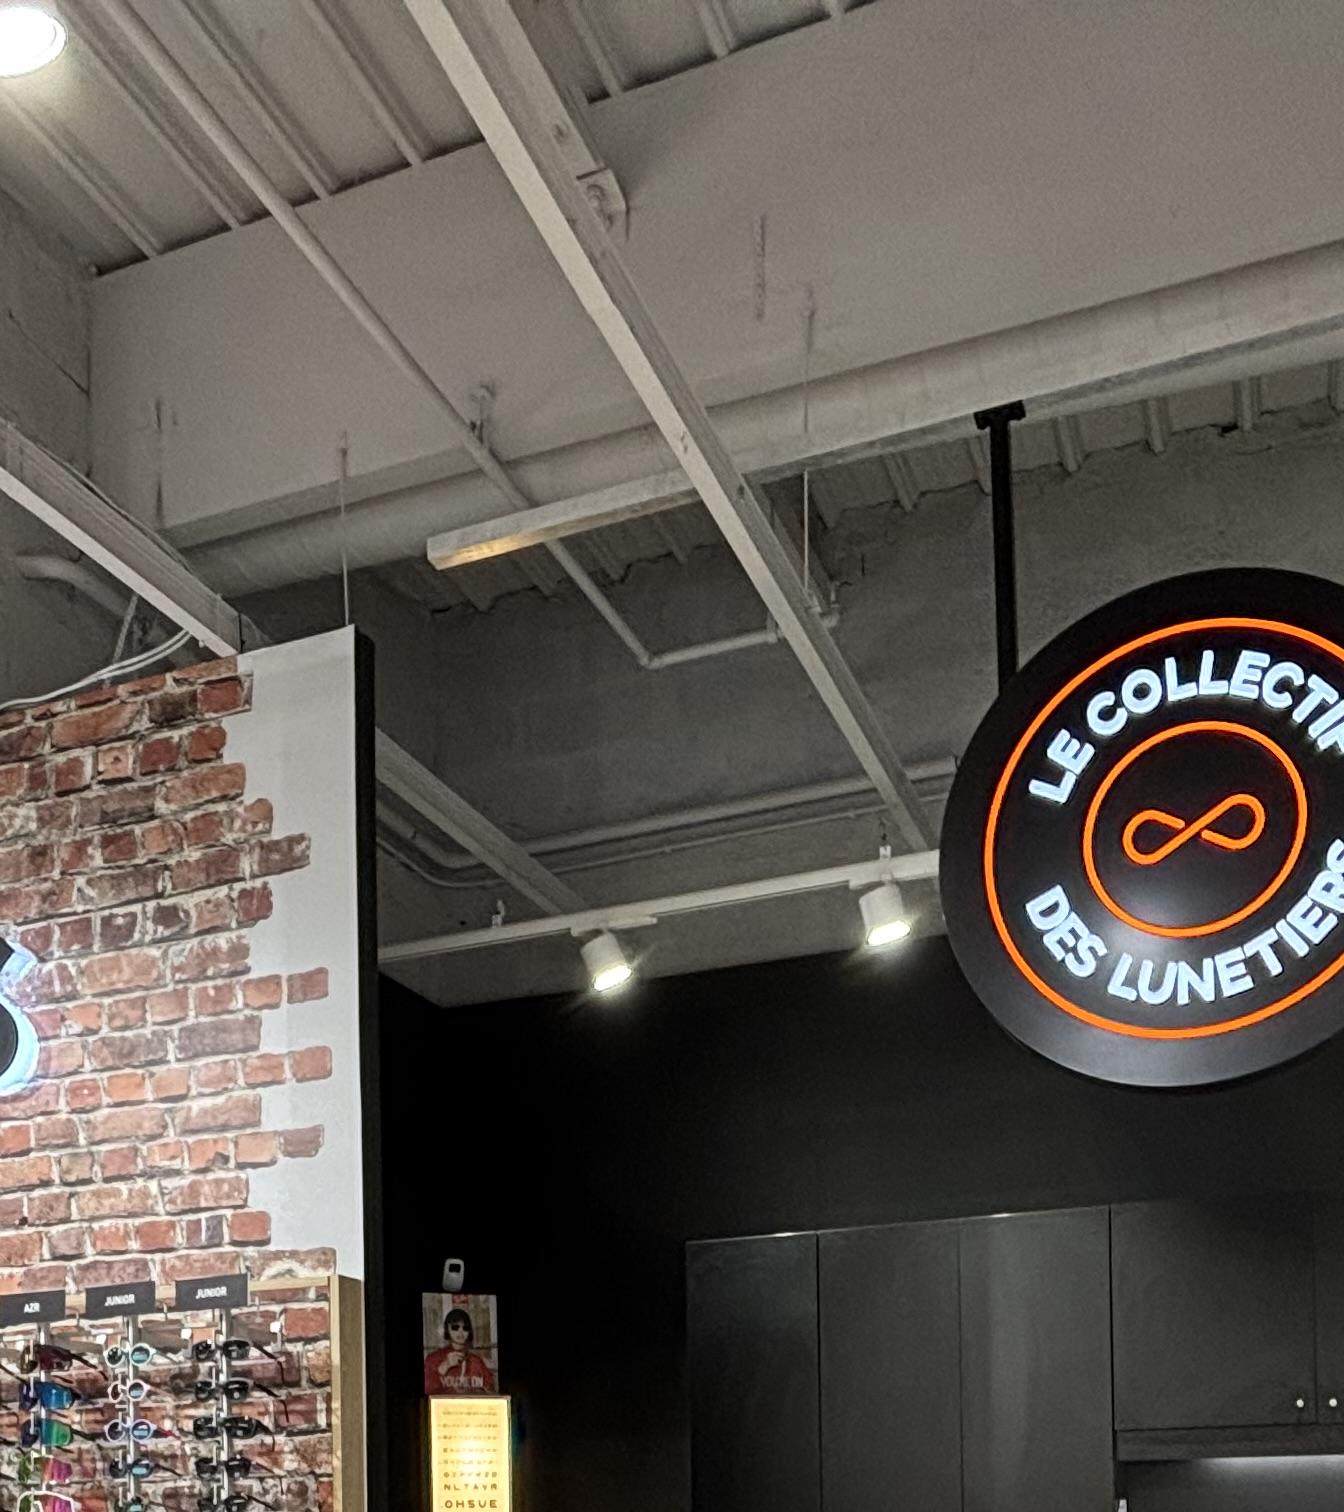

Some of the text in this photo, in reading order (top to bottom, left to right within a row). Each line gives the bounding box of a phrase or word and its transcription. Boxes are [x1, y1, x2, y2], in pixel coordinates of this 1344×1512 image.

[1028, 729, 1096, 805] LE
[1025, 884, 1108, 979] DES
[194, 1286, 228, 1299] JUNIOR
